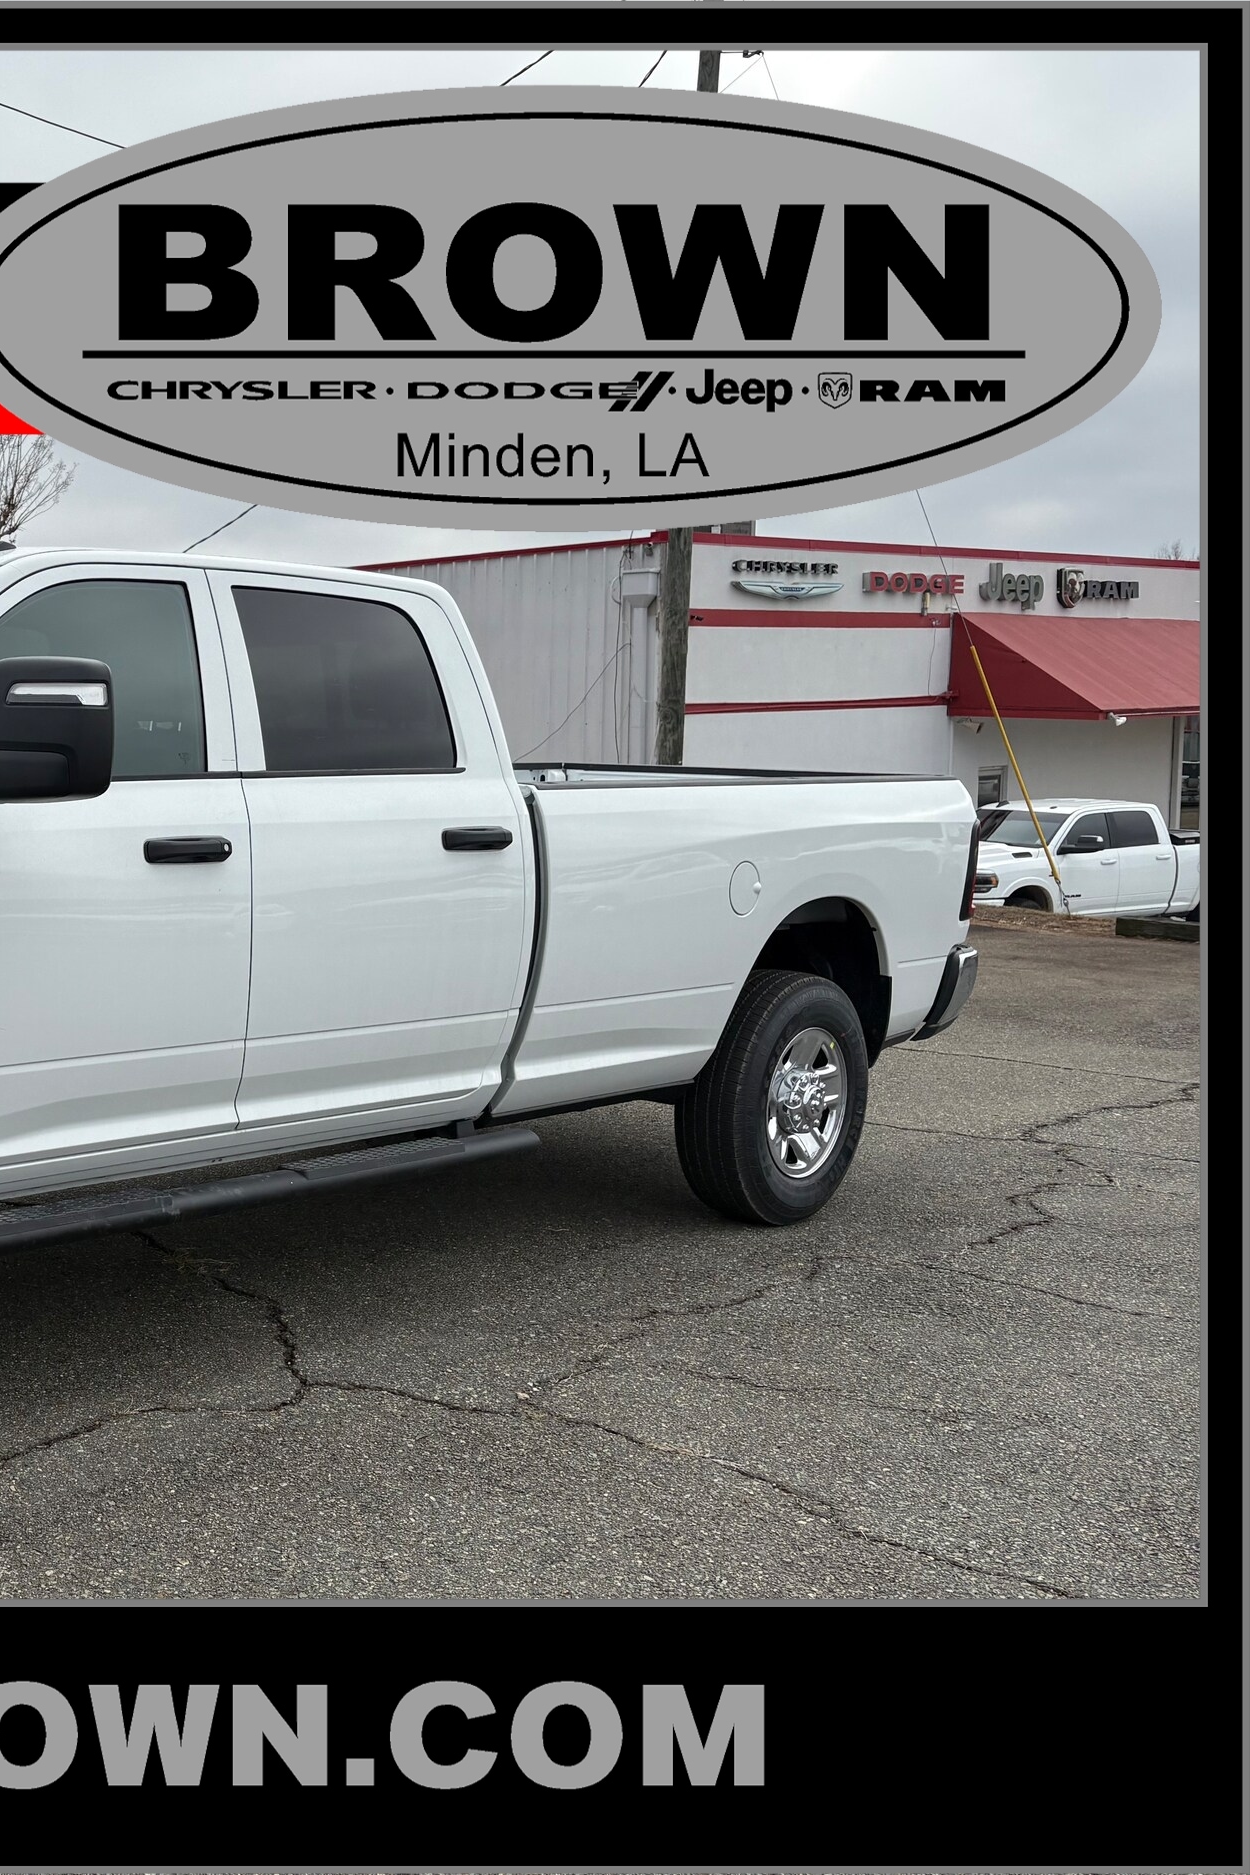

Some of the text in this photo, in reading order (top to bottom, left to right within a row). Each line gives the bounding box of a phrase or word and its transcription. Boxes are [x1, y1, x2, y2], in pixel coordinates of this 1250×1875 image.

[732, 559, 839, 576] CHRYSLER
[867, 571, 965, 595] DODGE
[981, 563, 1044, 609] Jeep
[1086, 580, 1140, 599] RAM
